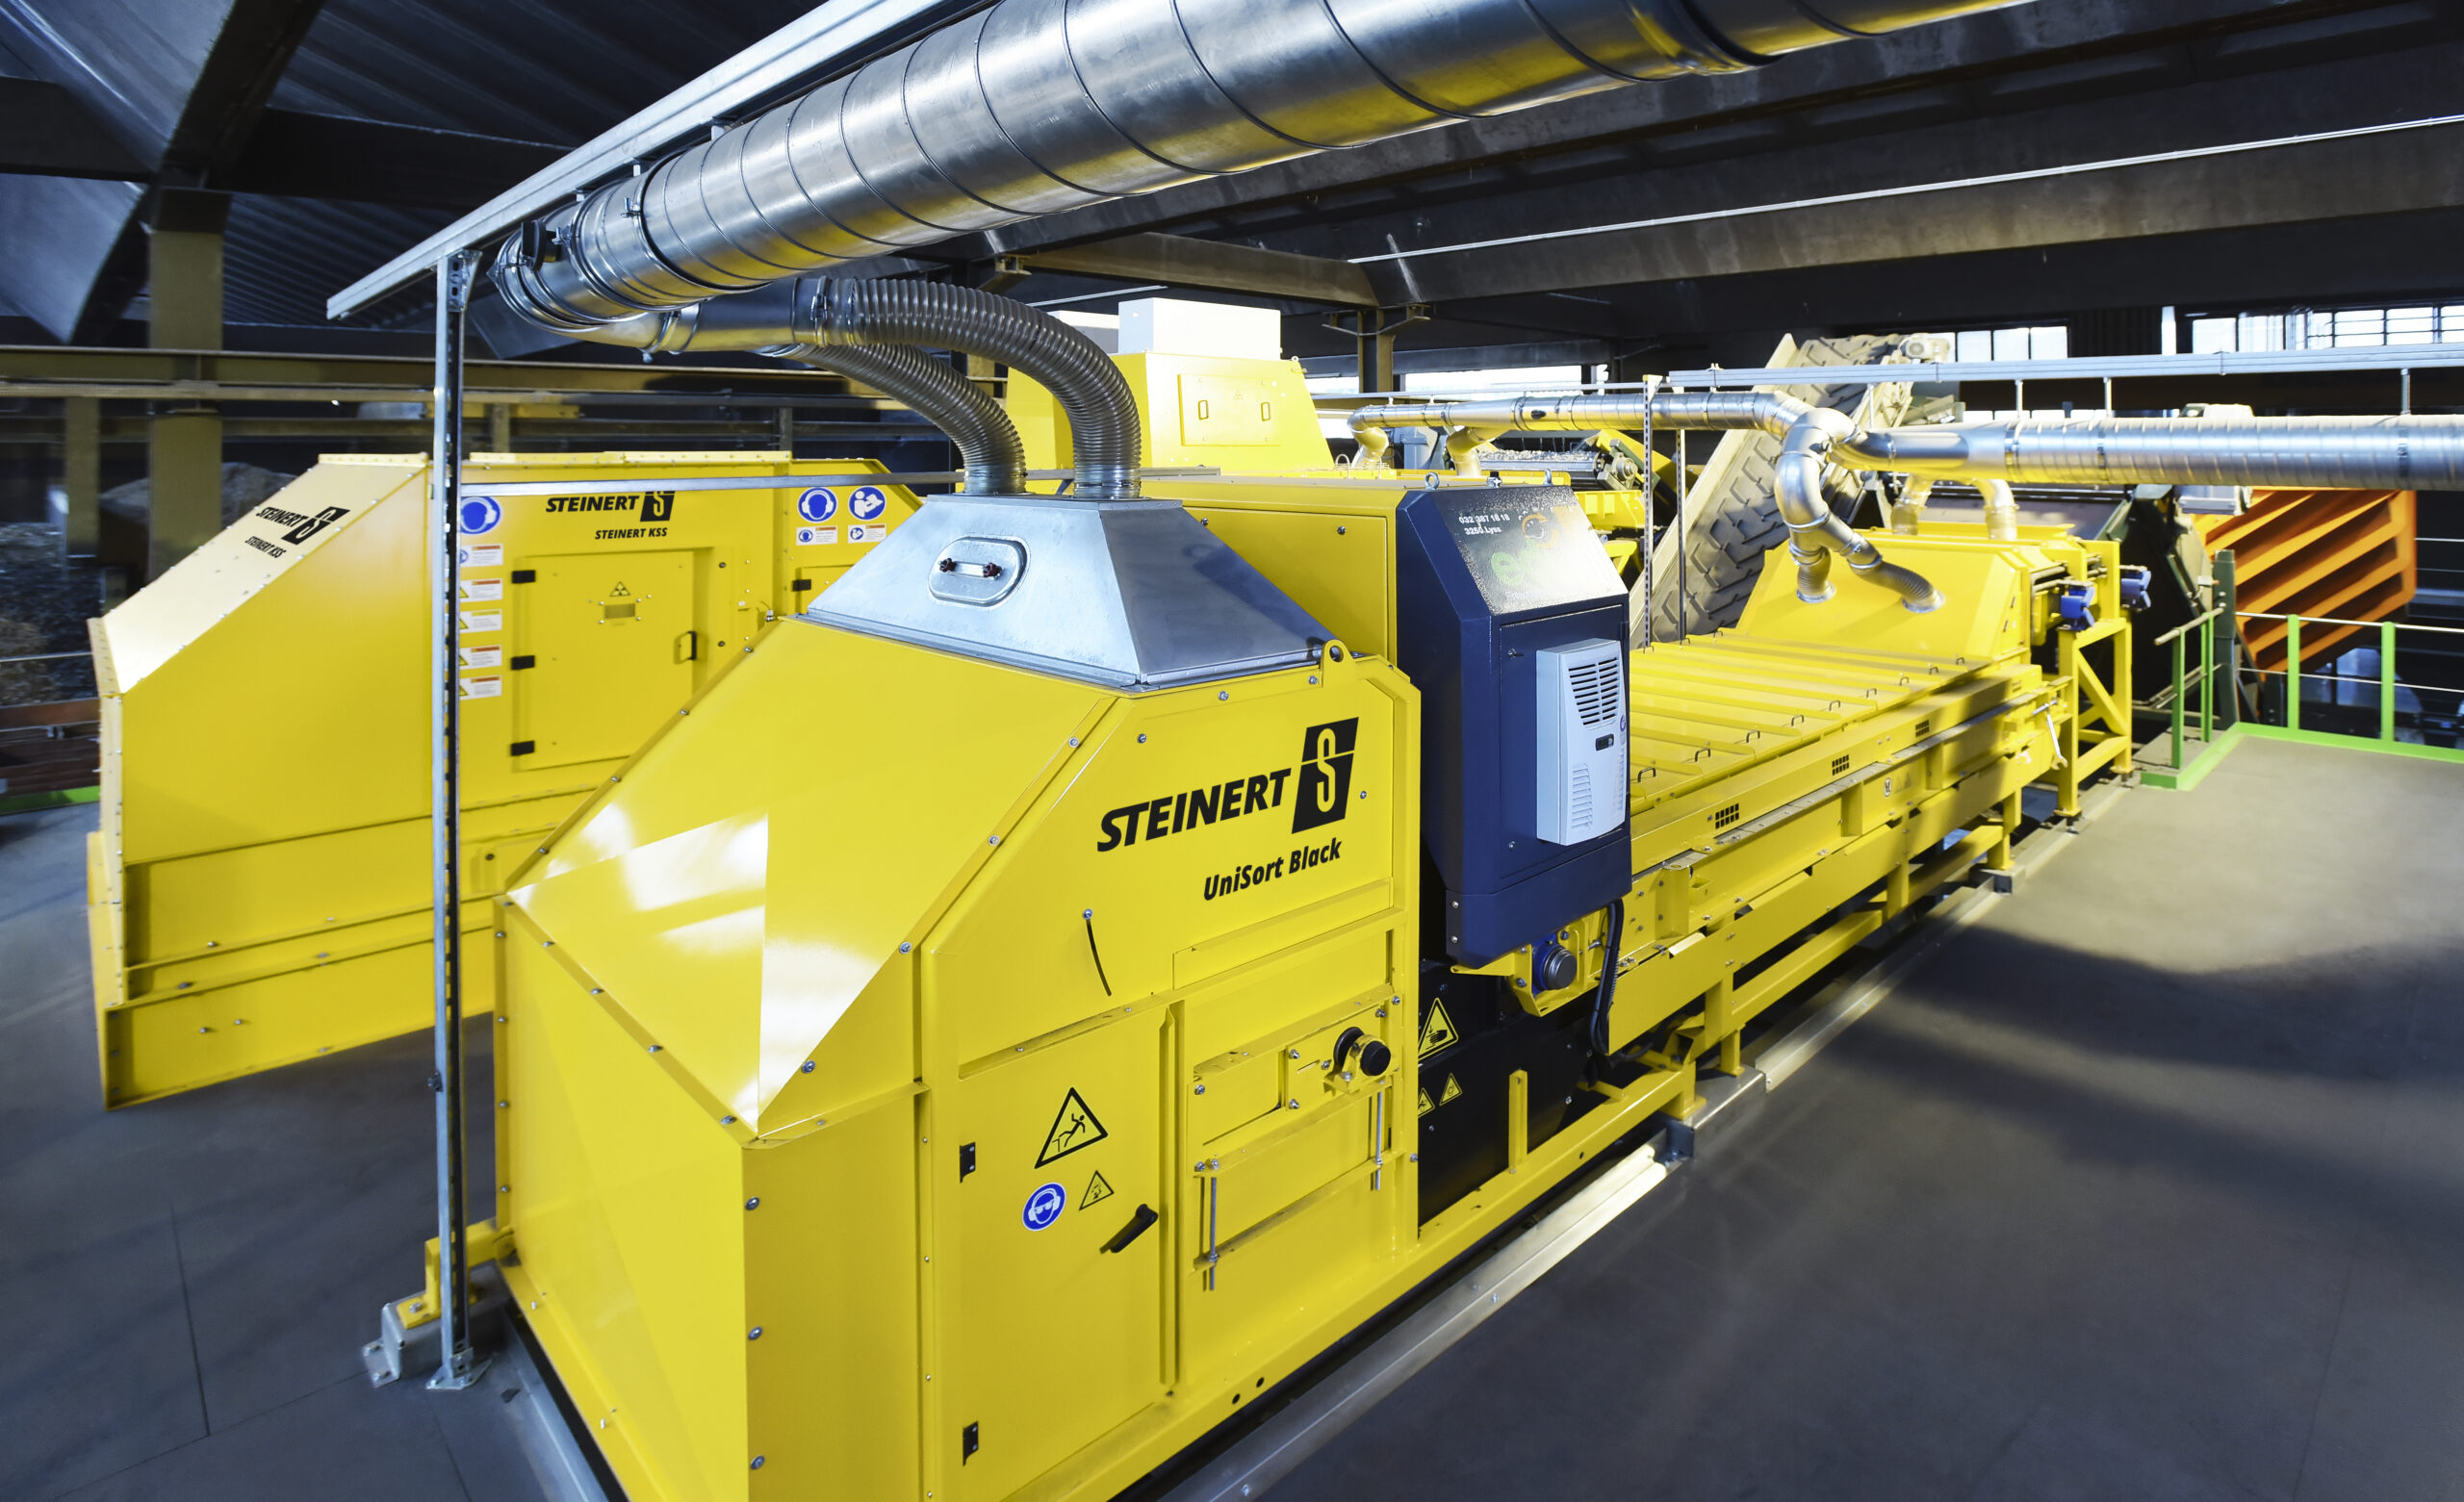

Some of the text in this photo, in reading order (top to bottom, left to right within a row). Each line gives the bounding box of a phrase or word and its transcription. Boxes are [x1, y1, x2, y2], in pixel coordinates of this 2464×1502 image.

[546, 496, 640, 513] STEINERT
[256, 506, 310, 528] STEINERT
[1458, 516, 1476, 524] 032
[595, 527, 668, 540] STEINERT KSS
[1464, 526, 1502, 535] 3250 Lyss
[244, 536, 275, 553] STEINERT
[1096, 767, 1293, 853] STEINERT
[1203, 837, 1343, 902] UniSort Black
